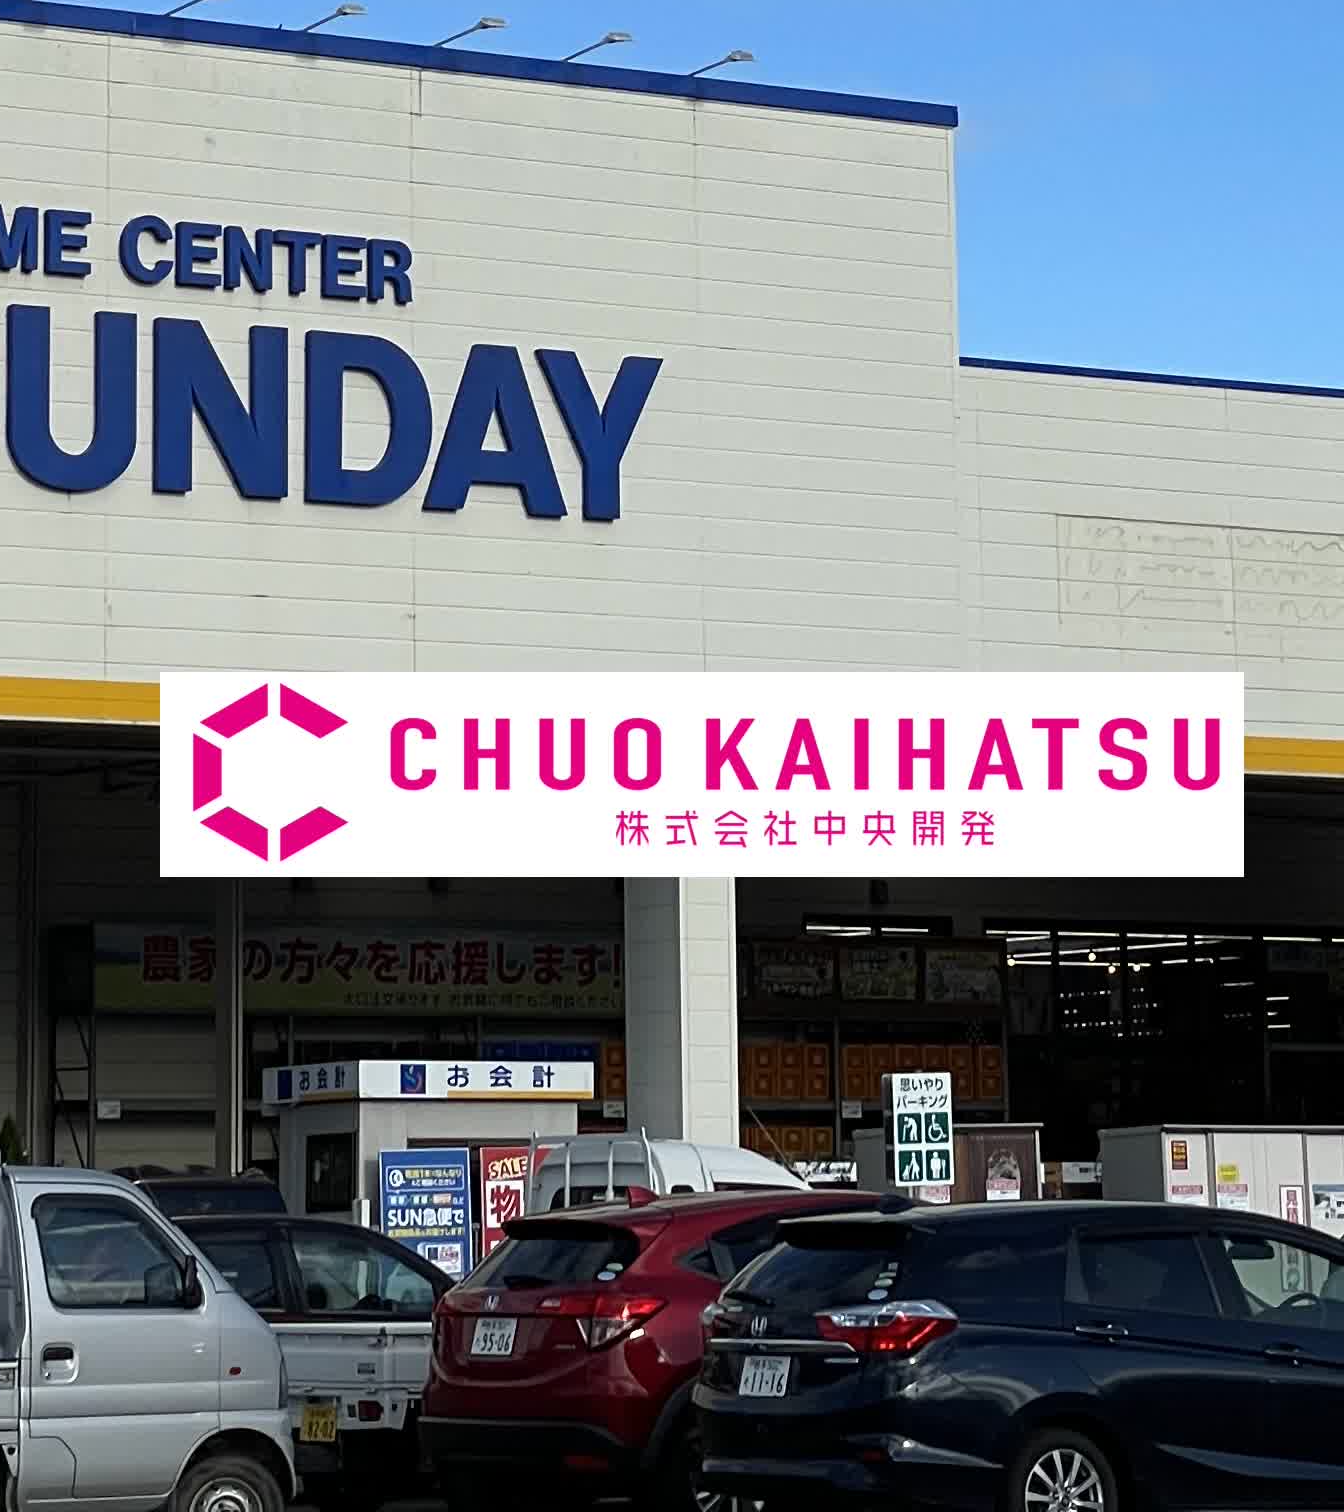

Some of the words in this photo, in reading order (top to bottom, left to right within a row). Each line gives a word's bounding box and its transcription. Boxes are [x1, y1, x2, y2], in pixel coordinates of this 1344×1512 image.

[119, 214, 413, 304] CENTER
[298, 1064, 346, 1089] お会計
[447, 1064, 555, 1088] お会計
[900, 1077, 944, 1092] 思いやり
[897, 1094, 949, 1109] パーキング
[489, 1156, 528, 1179] SALE
[490, 1184, 524, 1223] 物
[751, 1371, 785, 1393] 11-16
